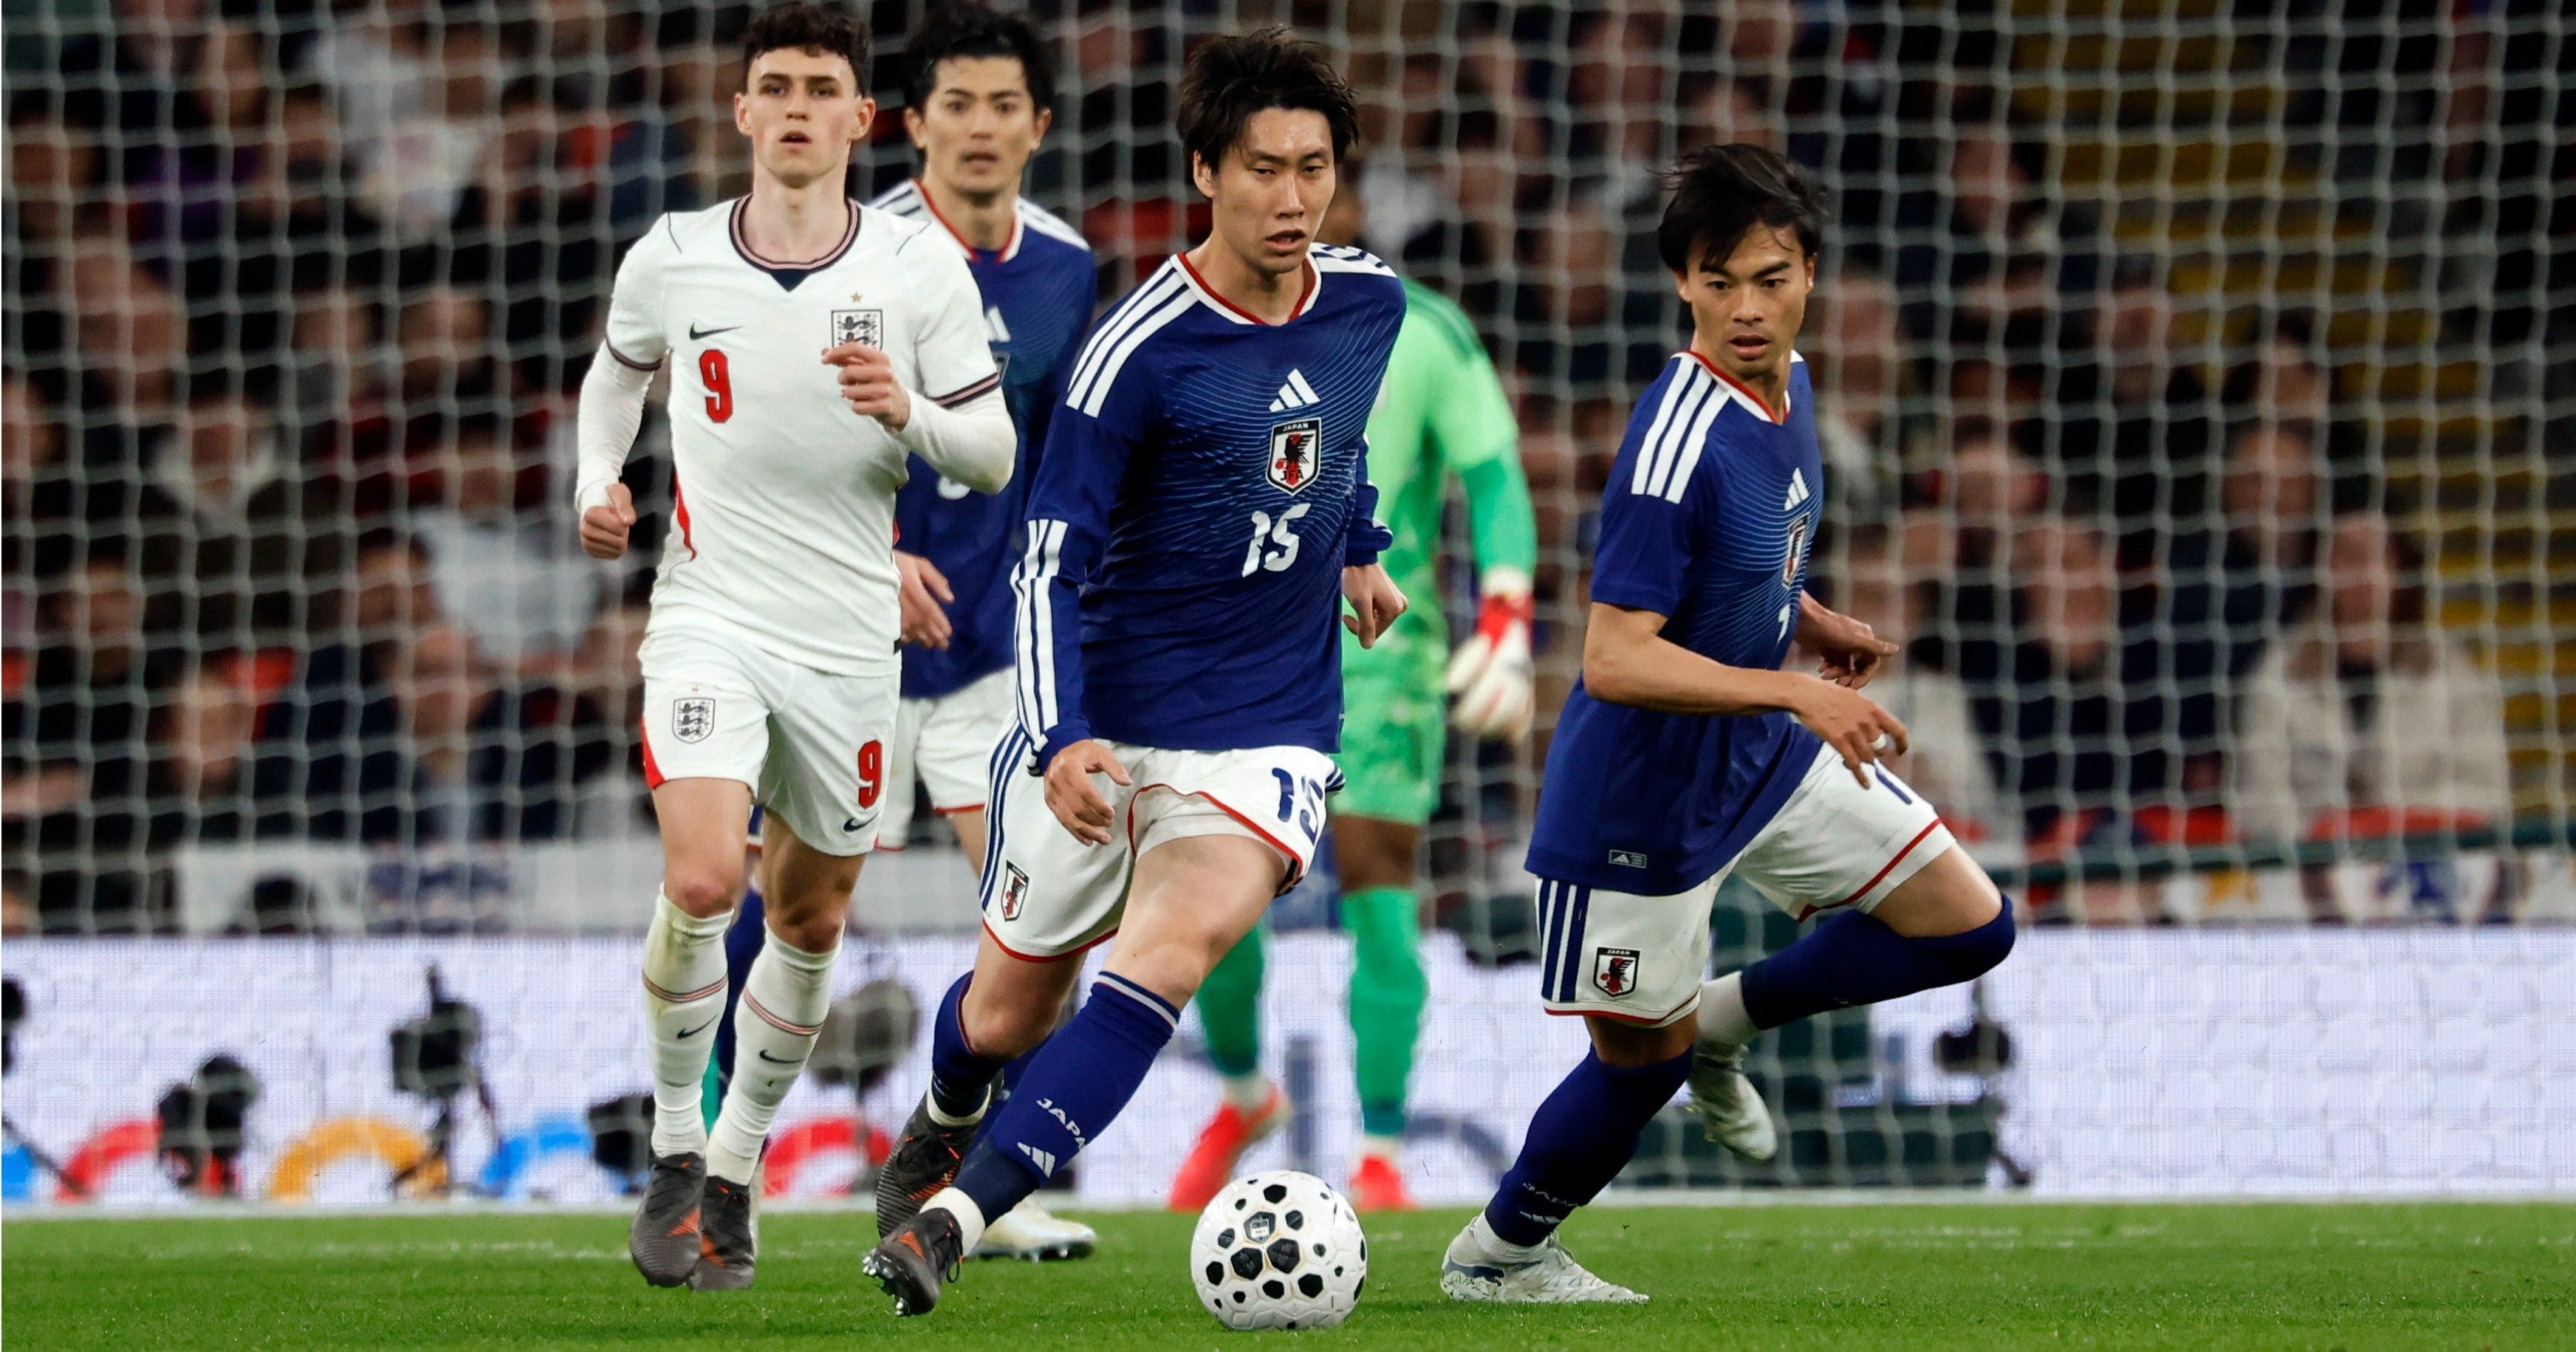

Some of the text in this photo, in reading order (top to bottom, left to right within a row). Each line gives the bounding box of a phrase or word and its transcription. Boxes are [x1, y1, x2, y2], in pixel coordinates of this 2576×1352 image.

[699, 349, 733, 424] 9
[1283, 422, 1309, 431] JAPAN
[1241, 503, 1312, 577] 15
[857, 739, 883, 809] 9
